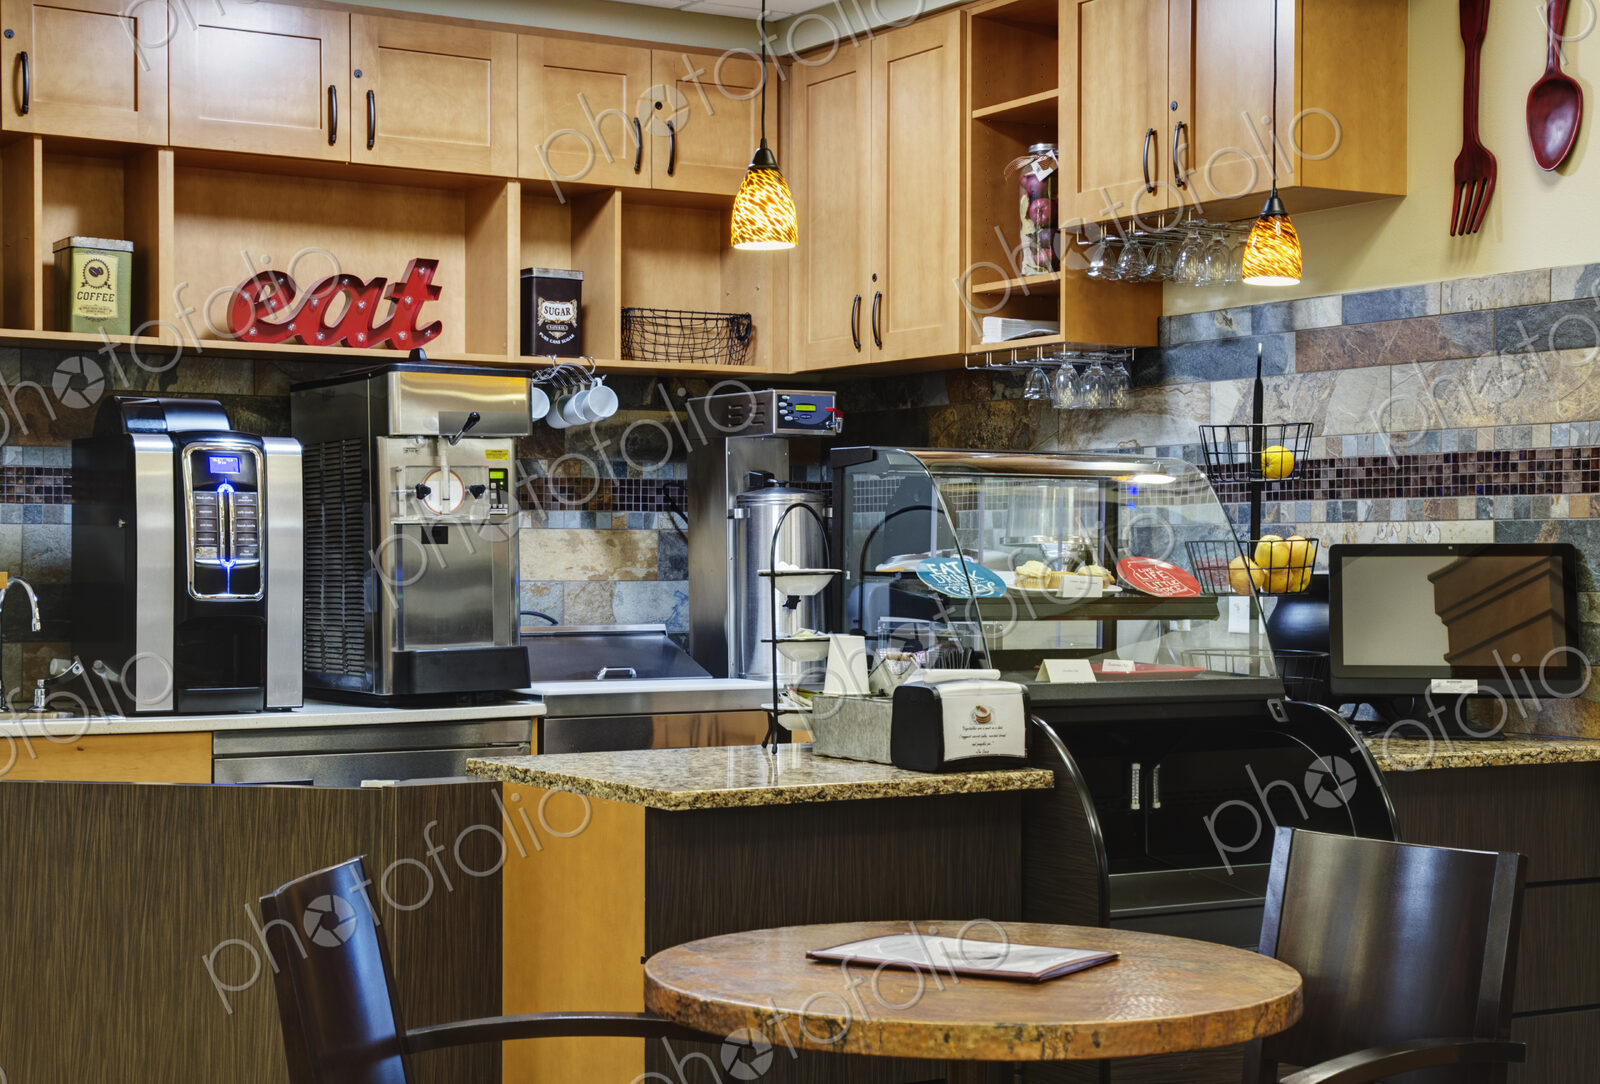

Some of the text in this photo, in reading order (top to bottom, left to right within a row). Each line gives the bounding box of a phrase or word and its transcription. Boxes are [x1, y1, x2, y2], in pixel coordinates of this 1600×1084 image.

[76, 290, 115, 302] COFFEE
[227, 257, 443, 350] eat
[543, 305, 571, 316] SUGAR
[926, 561, 965, 576] EAT
[929, 570, 984, 584] DRINK
[1135, 570, 1169, 581] LIFE
